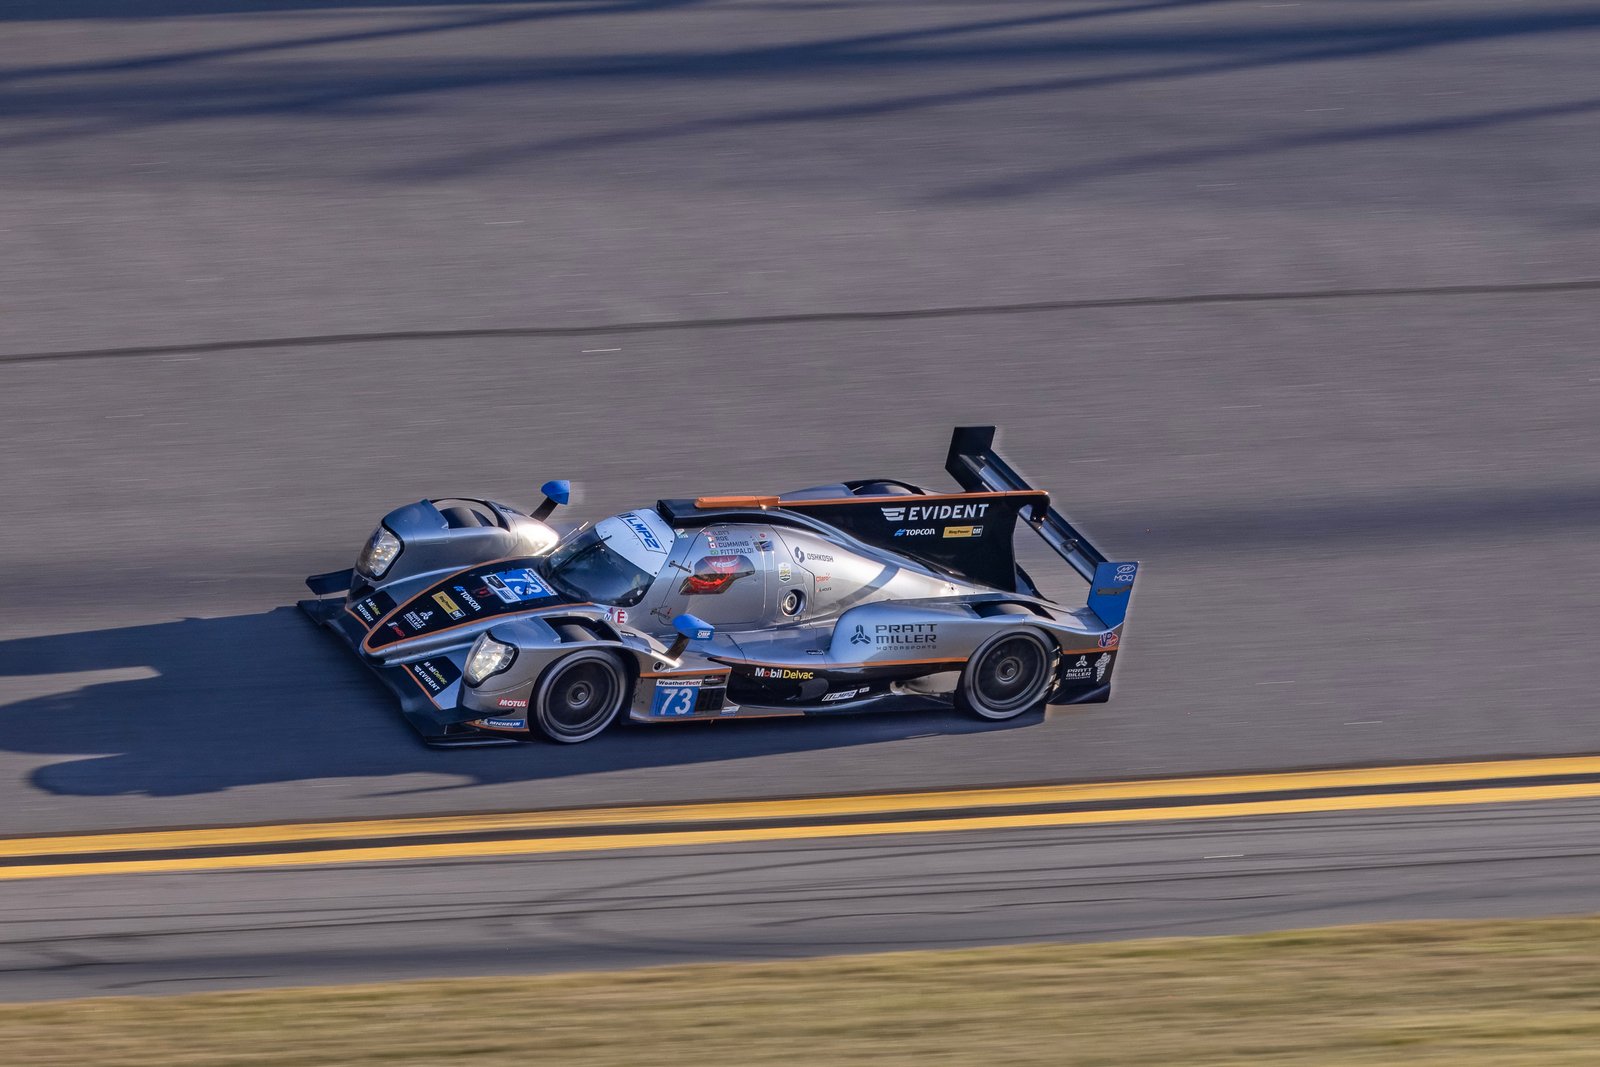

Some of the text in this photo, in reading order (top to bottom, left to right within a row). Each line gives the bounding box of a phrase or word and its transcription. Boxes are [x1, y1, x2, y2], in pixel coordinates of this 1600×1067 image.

[908, 503, 990, 521] EVIDENT
[626, 518, 660, 549] LMP2
[905, 528, 936, 536] TOPCON
[718, 540, 750, 548] CUMMING
[720, 547, 755, 555] FITTIPALDI
[806, 553, 834, 563] OSHKOSH
[460, 591, 482, 612] TOPCON
[617, 611, 625, 623] E
[875, 623, 938, 634] PRATT
[875, 634, 937, 644] MILLER
[423, 661, 436, 673] Mbil
[754, 667, 814, 680] Mobil Delvac
[418, 670, 441, 691] EVIDENT
[499, 699, 526, 707] MOTUL
[660, 688, 693, 715] 73
